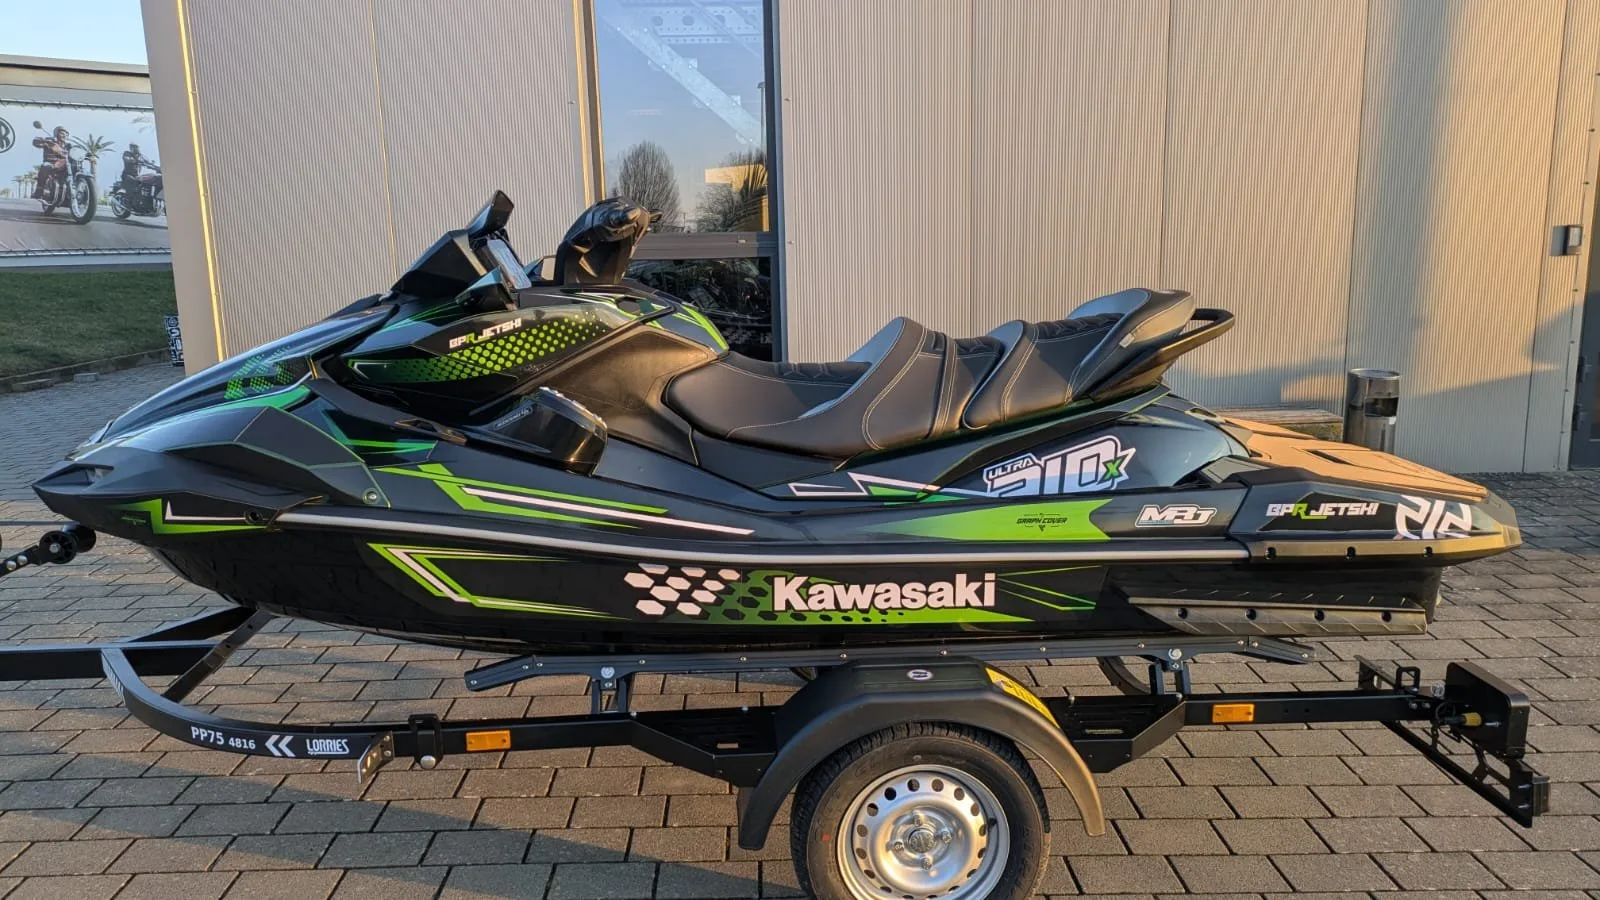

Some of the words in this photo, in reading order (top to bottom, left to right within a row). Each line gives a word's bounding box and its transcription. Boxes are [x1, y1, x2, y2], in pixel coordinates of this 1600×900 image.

[988, 457, 1035, 479] ULTRA
[1310, 503, 1380, 516] JETSKI
[773, 572, 996, 611] Kawasaki
[190, 726, 225, 745] PP75
[228, 736, 256, 750] 4816
[306, 738, 349, 754] LORRIES
